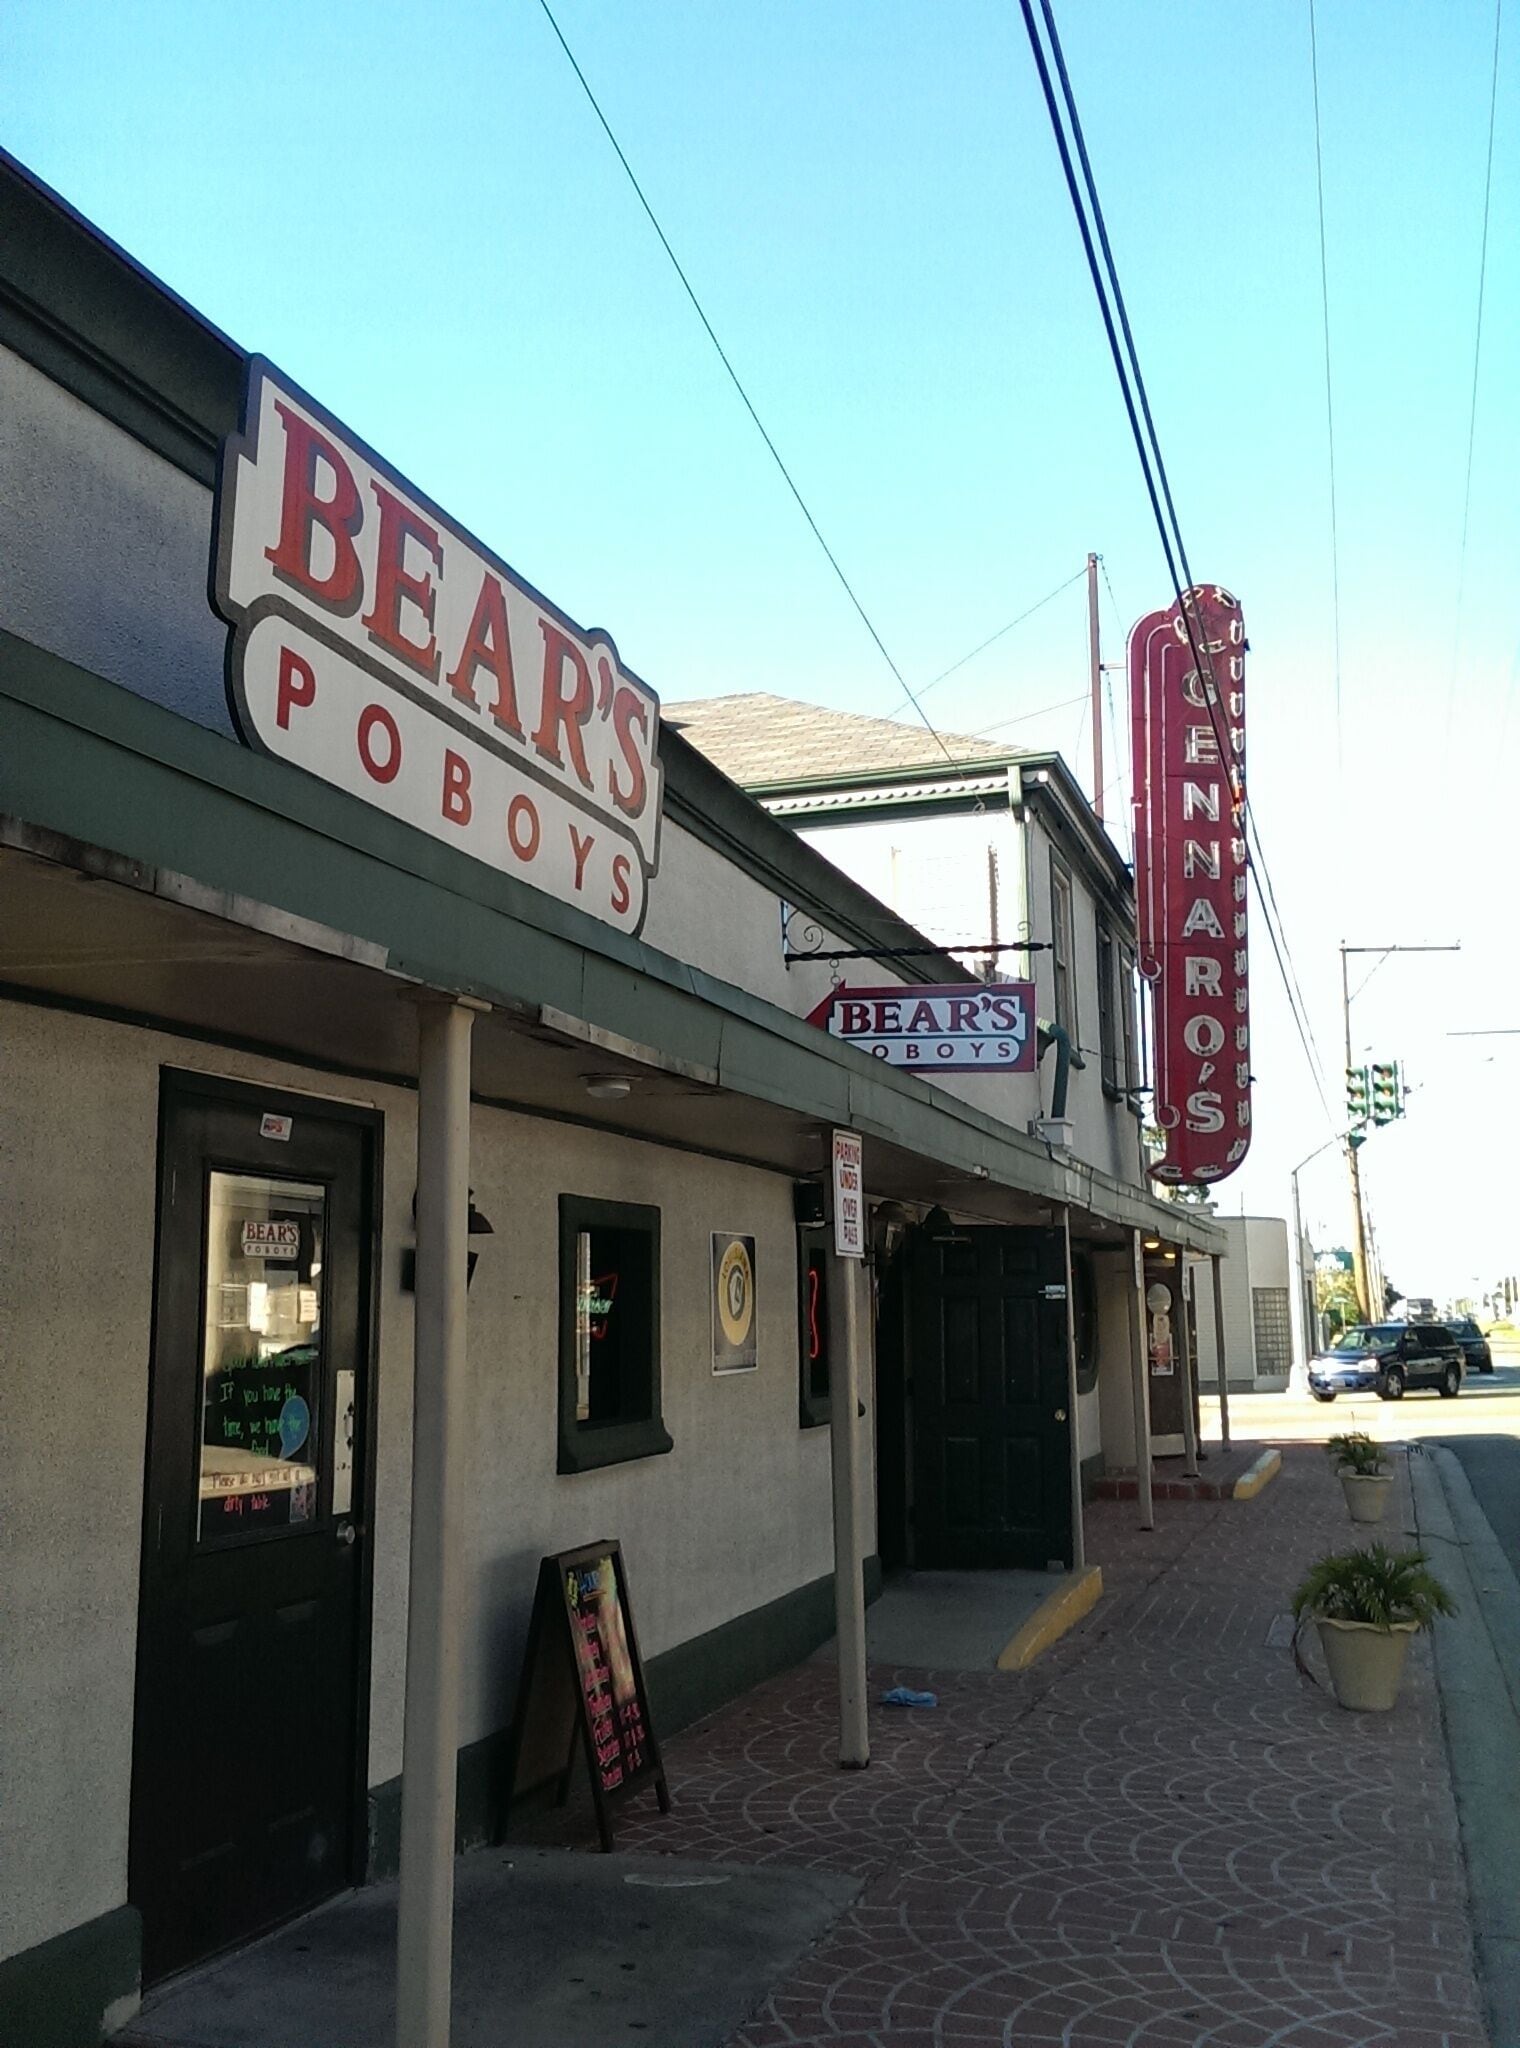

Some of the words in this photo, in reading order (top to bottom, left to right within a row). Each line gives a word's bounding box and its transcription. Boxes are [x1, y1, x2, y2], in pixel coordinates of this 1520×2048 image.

[264, 398, 648, 818] BEAR'S
[1182, 668, 1226, 1134] GENNARO'S
[839, 997, 1017, 1034] BEAR'S
[871, 1041, 1011, 1060] OBOYS
[835, 1140, 860, 1165] PARKING
[840, 1170, 858, 1191] UNDER
[843, 1197, 858, 1219] OVER
[246, 1223, 297, 1243] BEAR'S
